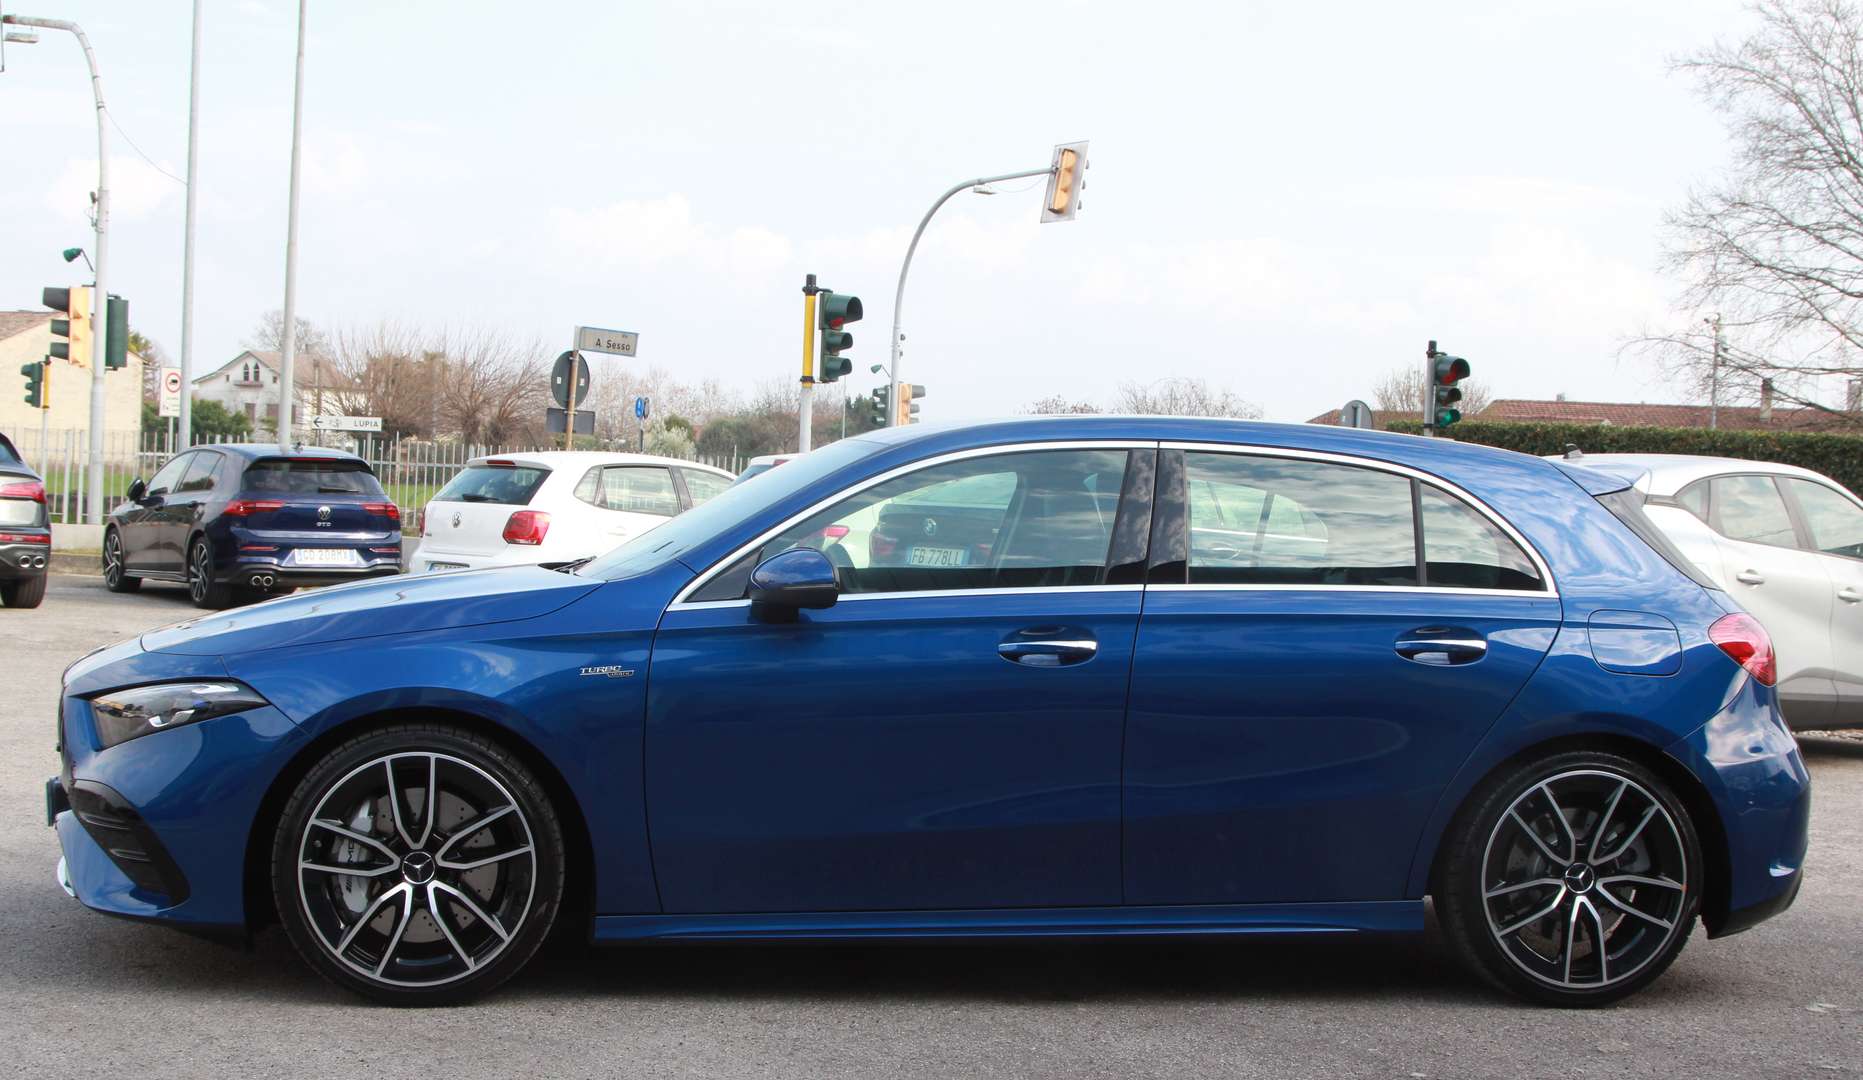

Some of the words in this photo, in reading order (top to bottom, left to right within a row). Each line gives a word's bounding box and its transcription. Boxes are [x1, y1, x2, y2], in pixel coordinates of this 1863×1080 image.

[606, 339, 631, 351] Sesso
[354, 420, 379, 428] LUPIA
[580, 665, 622, 674] TURBO
